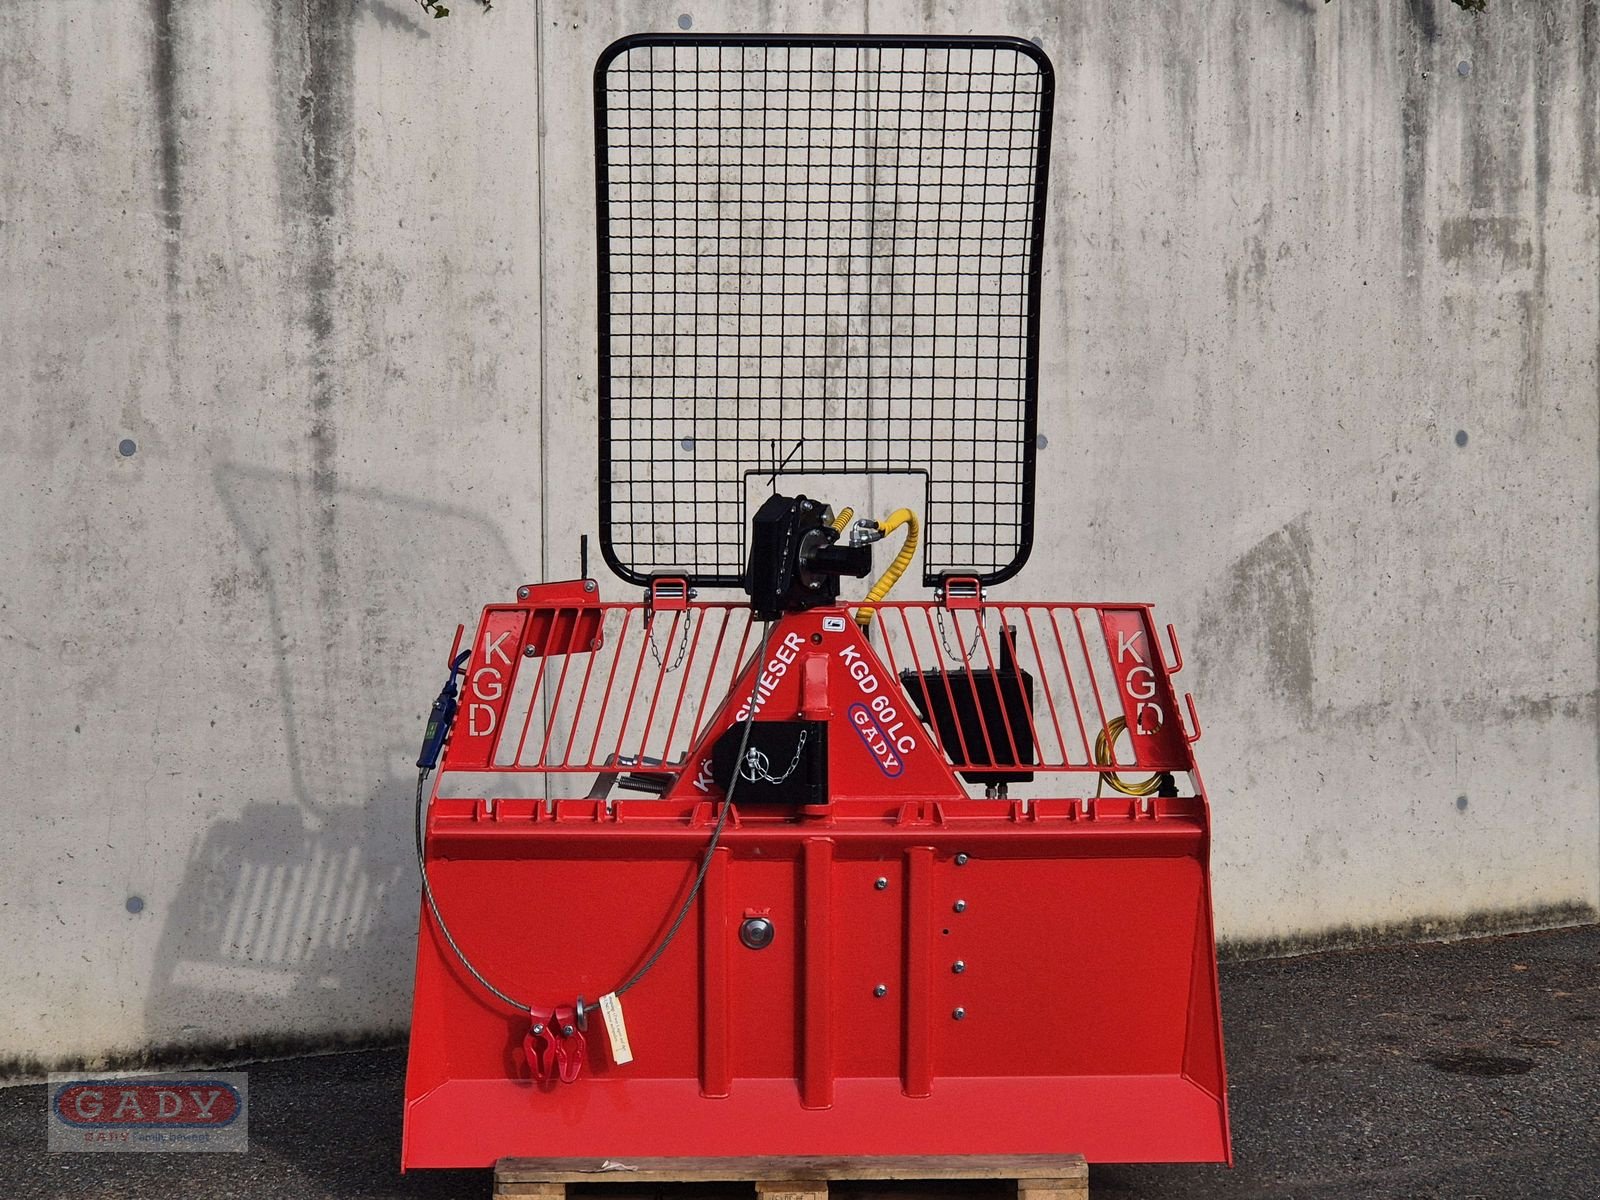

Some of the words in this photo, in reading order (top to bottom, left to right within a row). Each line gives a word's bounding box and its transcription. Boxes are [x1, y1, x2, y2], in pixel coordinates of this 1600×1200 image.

[469, 631, 512, 737] KGD
[839, 645, 878, 694] KGD
[1118, 631, 1164, 735] KGD
[854, 710, 899, 769] GADY
